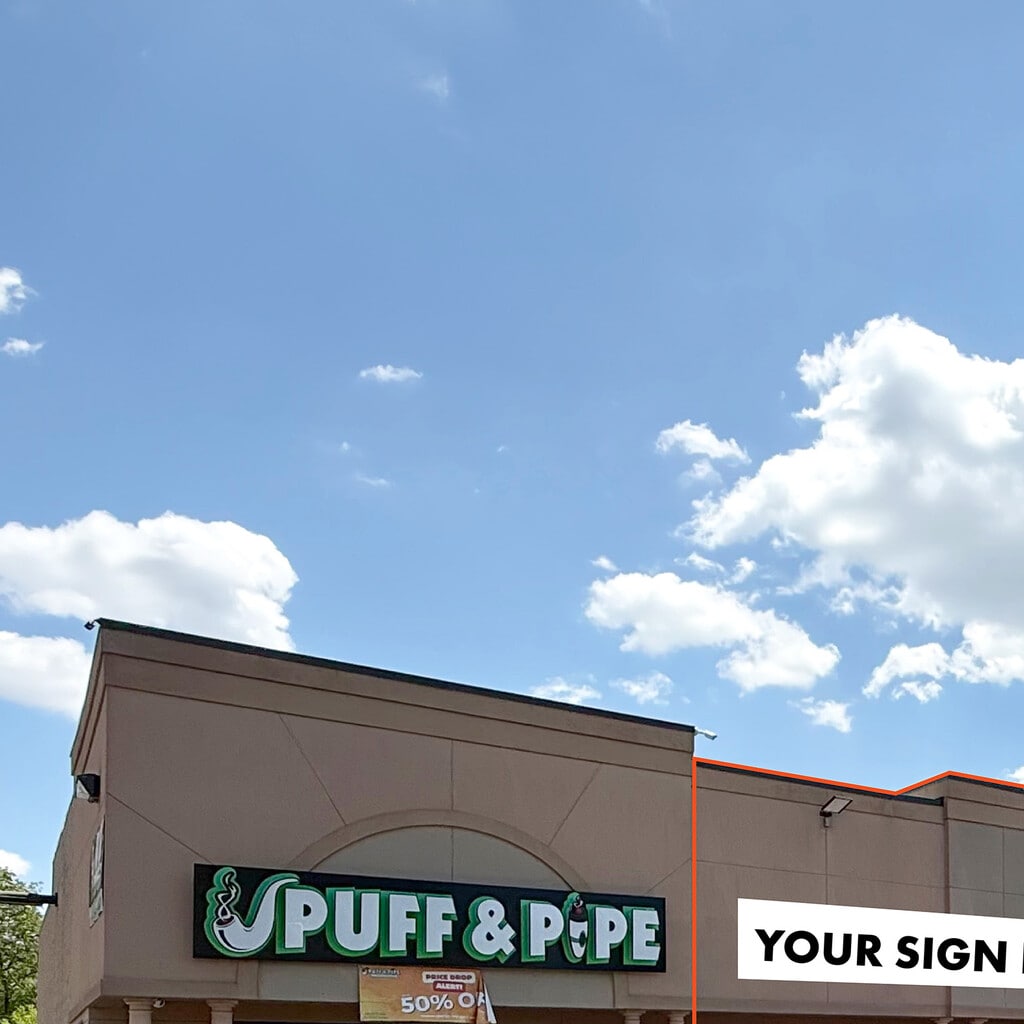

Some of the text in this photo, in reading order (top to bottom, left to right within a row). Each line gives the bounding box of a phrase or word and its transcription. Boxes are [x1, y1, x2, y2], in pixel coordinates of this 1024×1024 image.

[277, 885, 458, 959] PUFF
[463, 896, 516, 964] &
[435, 982, 464, 991] ALERT!
[401, 993, 454, 1014] 50%
